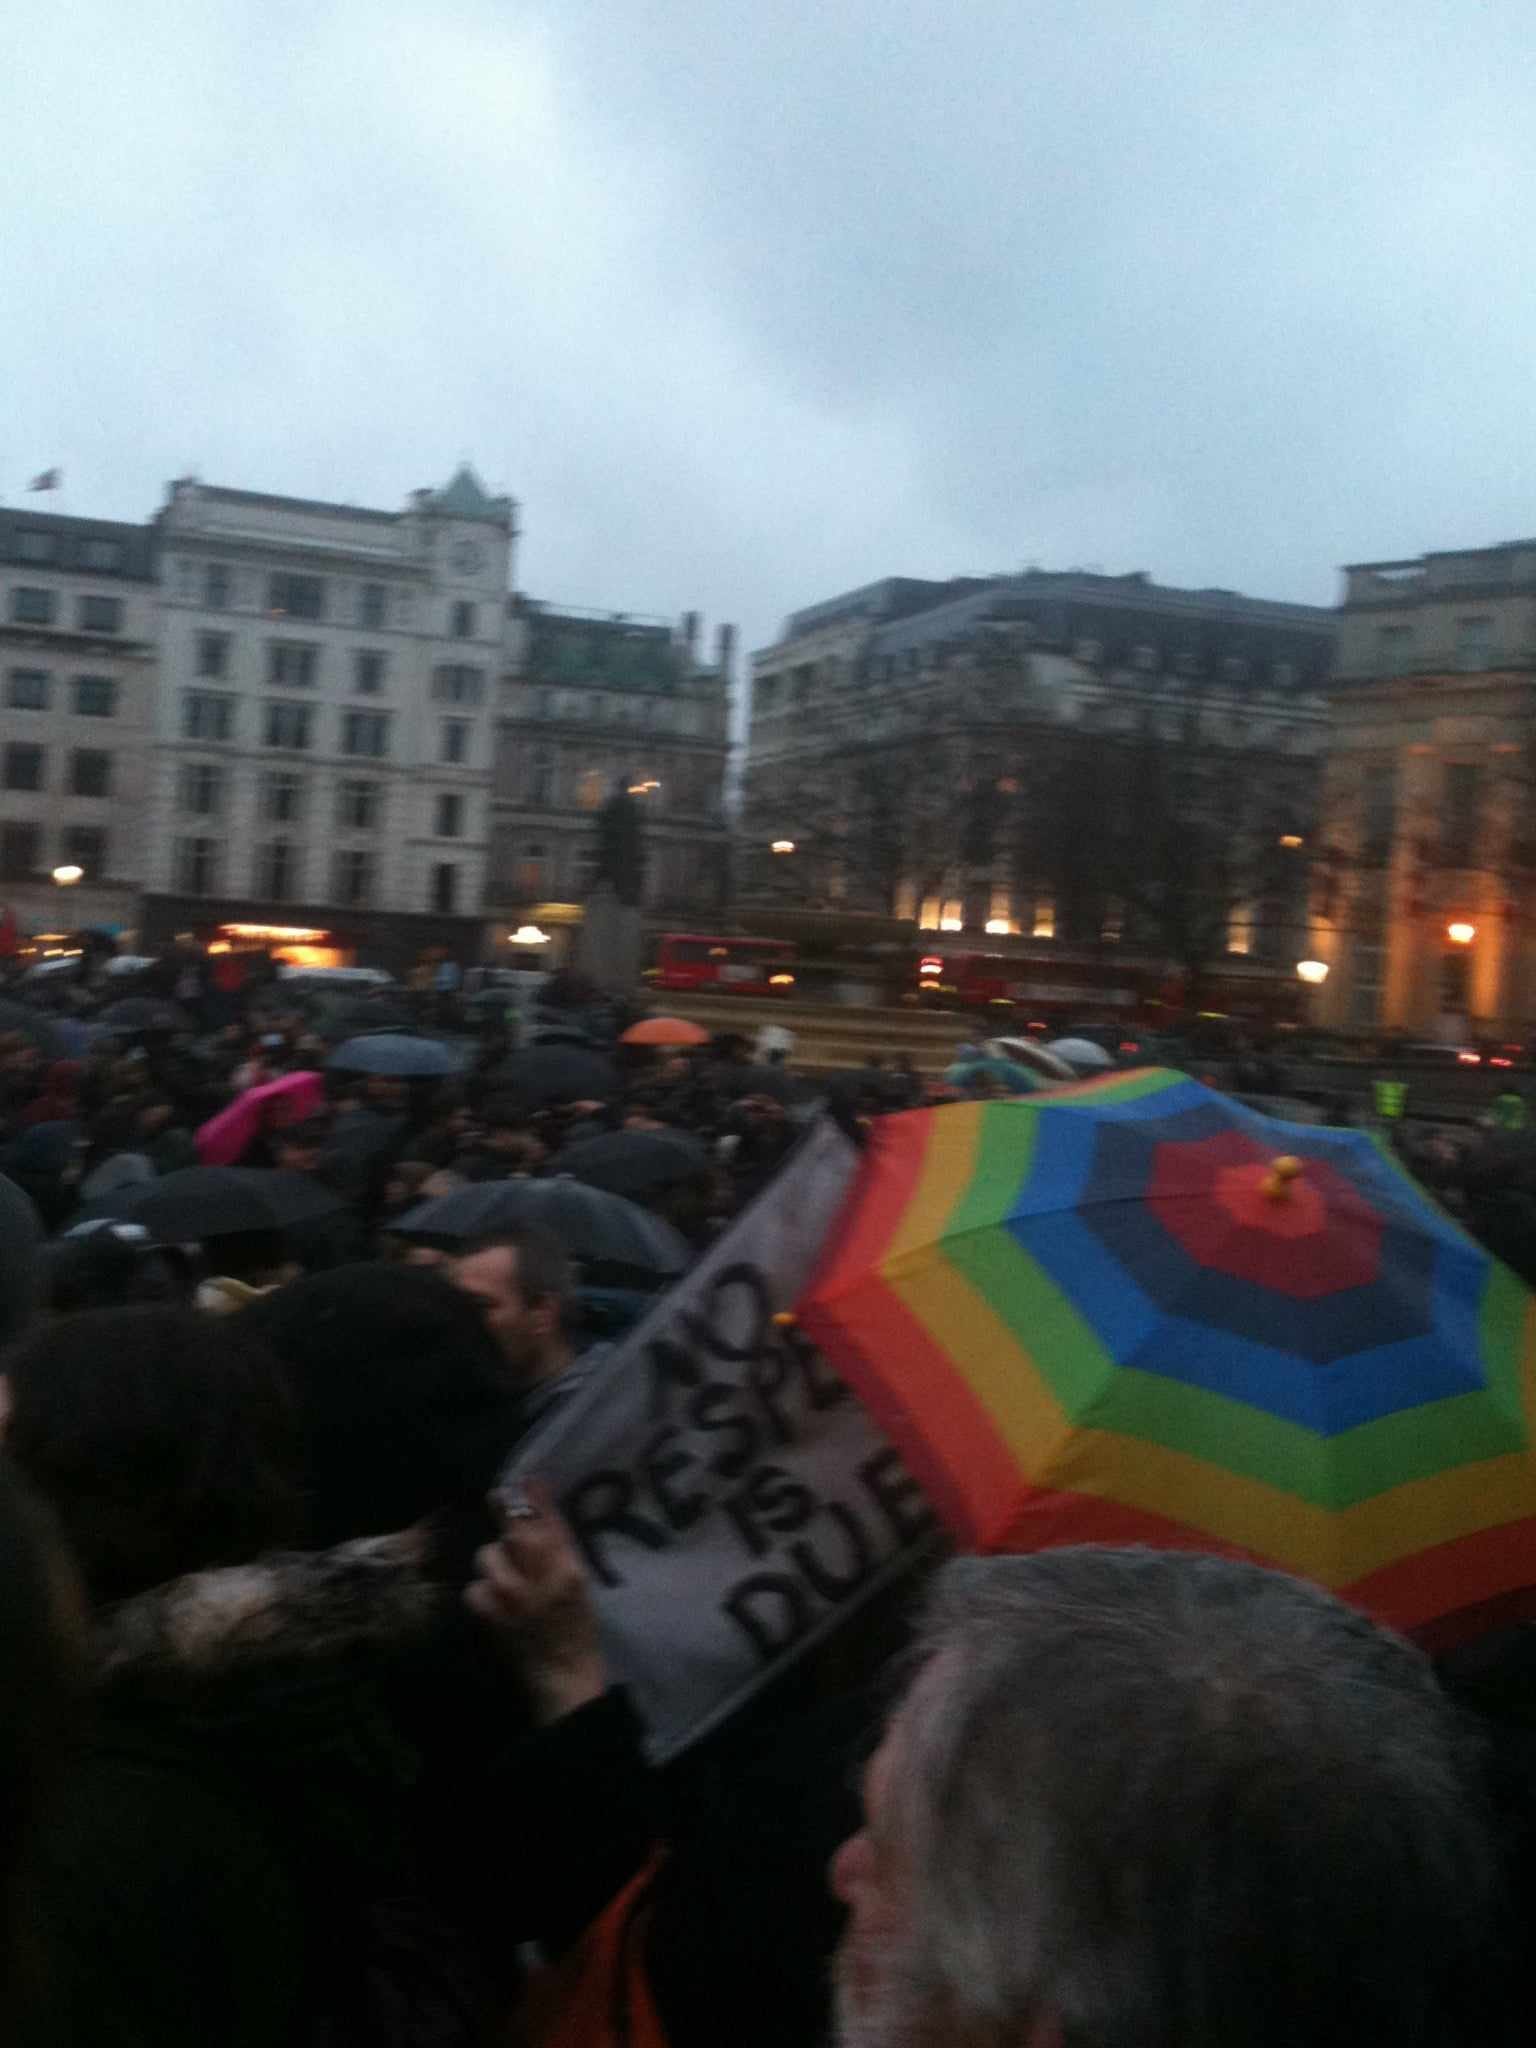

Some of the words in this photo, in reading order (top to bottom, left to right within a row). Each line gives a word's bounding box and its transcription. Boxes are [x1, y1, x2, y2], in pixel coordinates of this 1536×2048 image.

[566, 1322, 853, 1588] RESPE
[722, 1466, 816, 1556] IS
[722, 1448, 946, 1660] DUE
